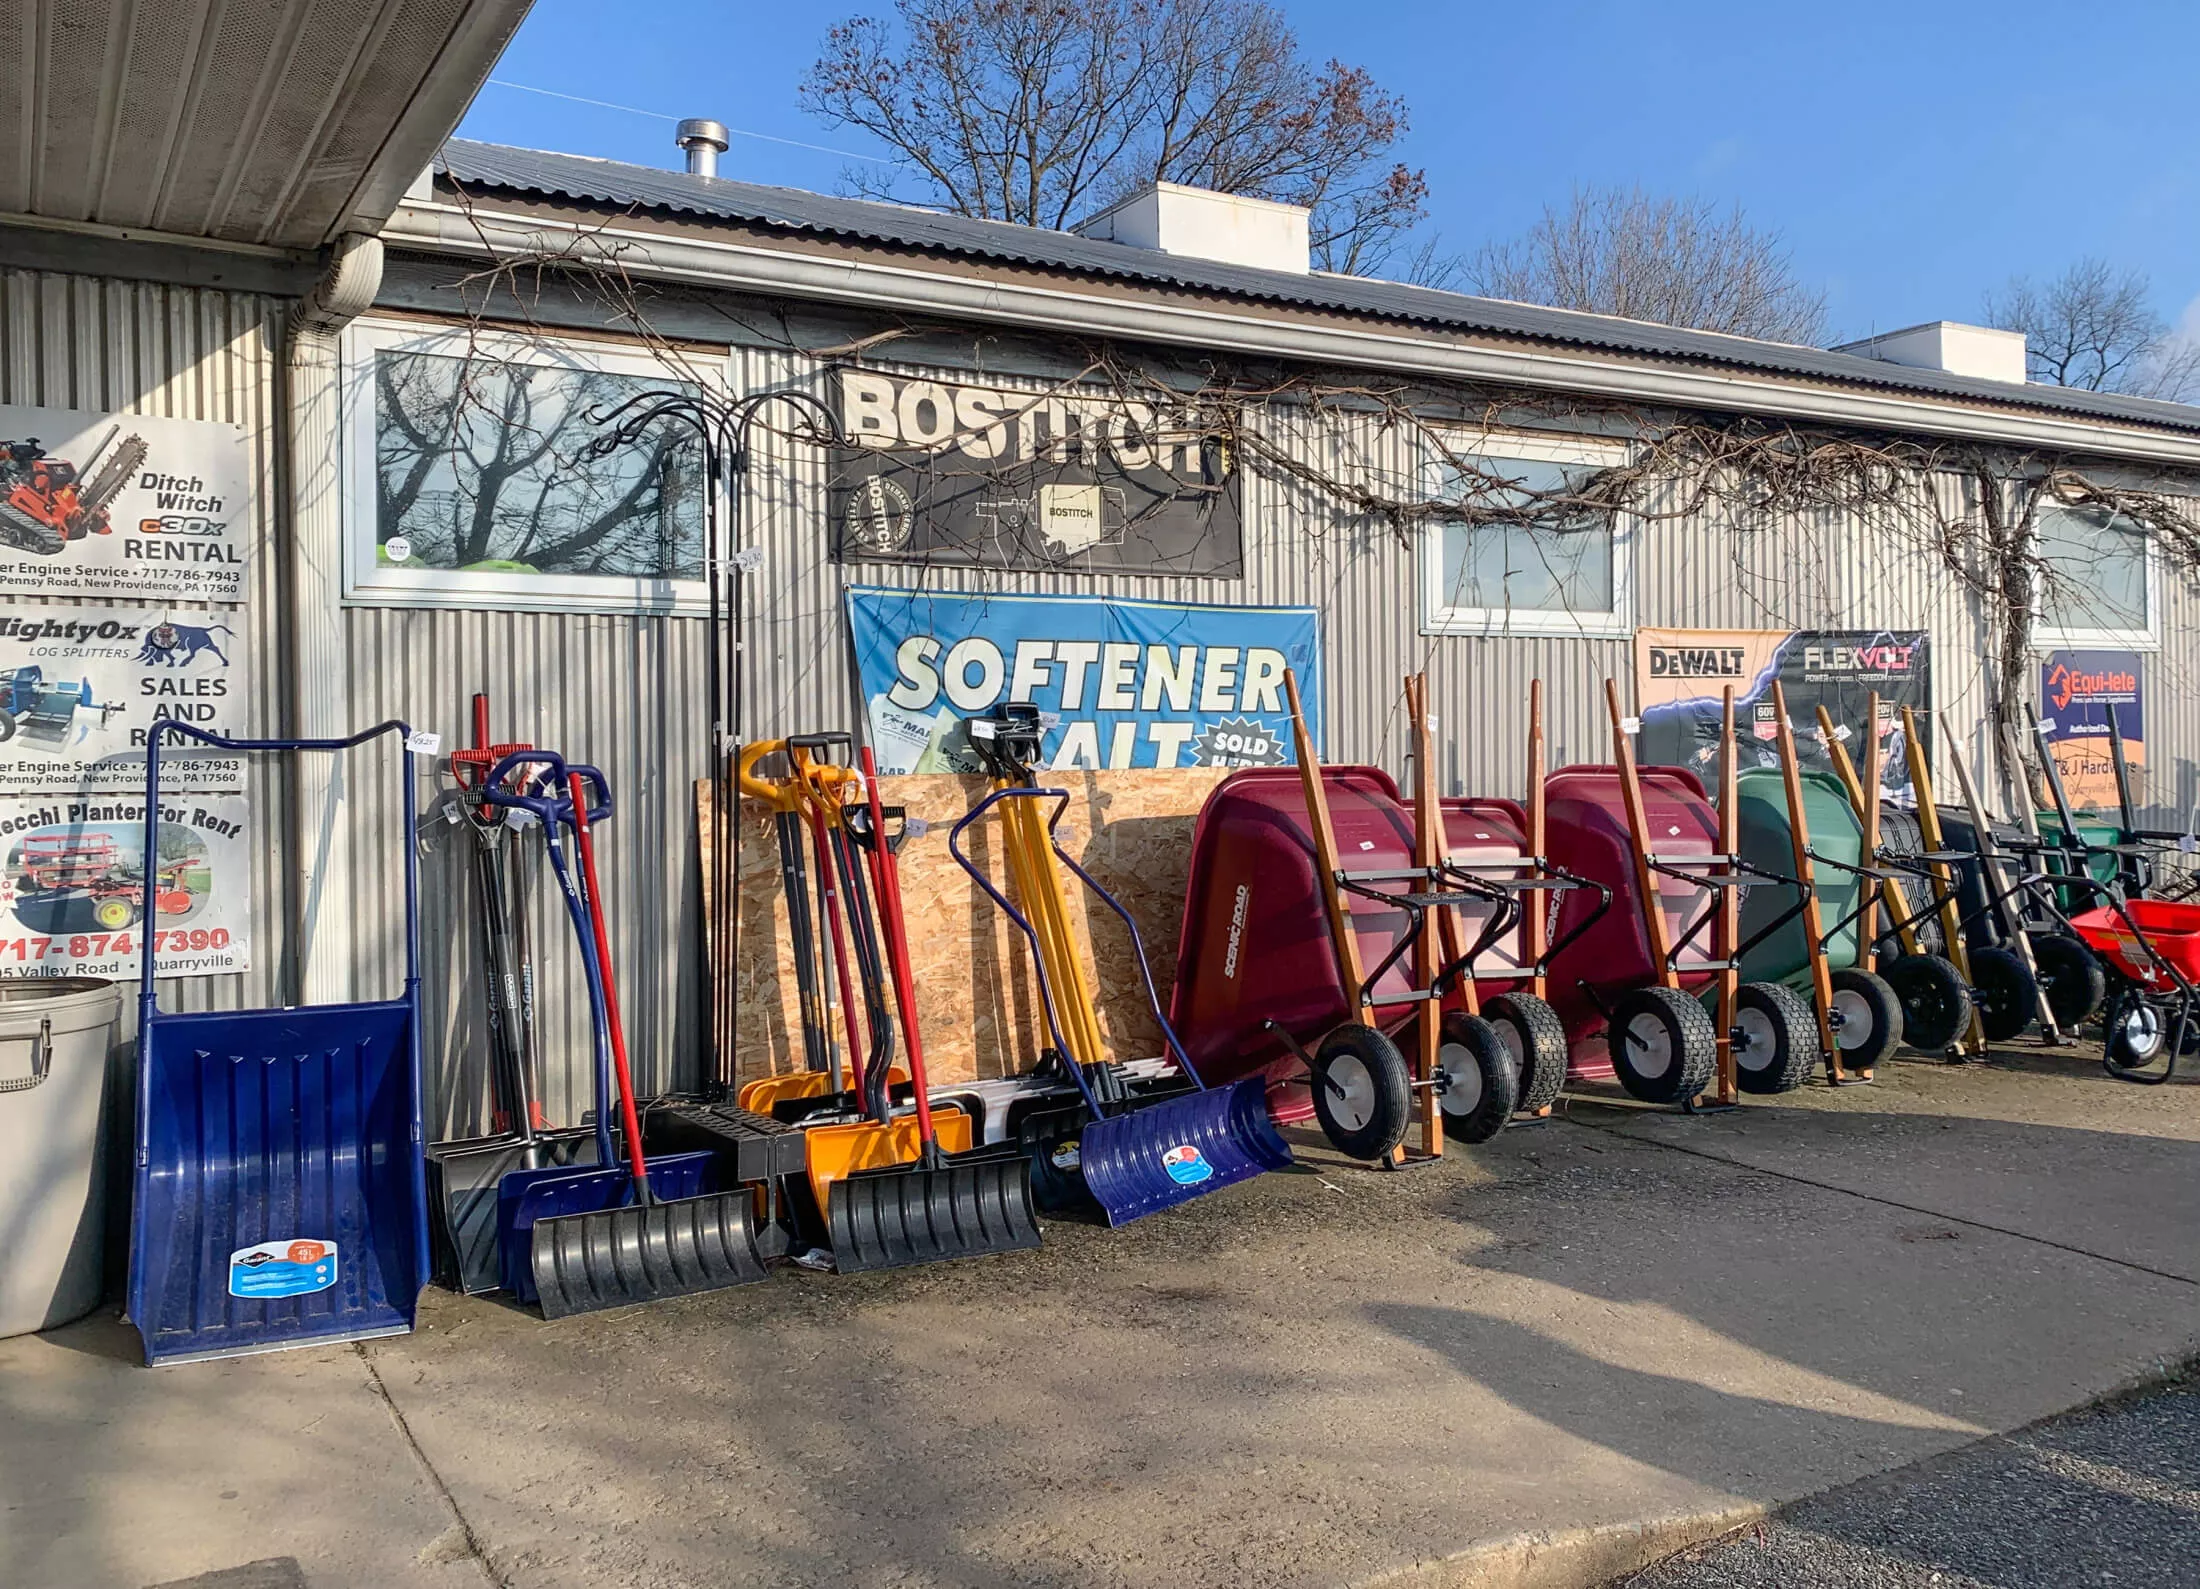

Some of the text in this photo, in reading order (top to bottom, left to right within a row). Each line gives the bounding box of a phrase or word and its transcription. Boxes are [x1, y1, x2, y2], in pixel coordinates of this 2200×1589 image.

[842, 373, 1201, 473] BOSTITCH
[140, 473, 203, 493] Ditch
[157, 492, 222, 513] Witch
[1049, 507, 1093, 518] BOSTITCH
[867, 474, 892, 553] BOSTITCH
[124, 539, 242, 563] RENTAL
[19, 563, 71, 577] Engine
[75, 564, 129, 577] Service
[142, 568, 240, 582] 717-786-7943
[0, 575, 237, 593] Pennsy Road, New Providence, PA 17560
[28, 647, 130, 658] LOG SPLITTERS
[1804, 646, 1913, 670] FLEXVOLT
[886, 636, 1287, 712] SOFTENER
[140, 678, 227, 697] SALES
[152, 704, 216, 721] AND
[1036, 721, 1195, 771] ALT
[1213, 732, 1270, 756] SOLD
[18, 761, 70, 774] Engine
[74, 761, 128, 771] Service
[141, 760, 239, 771] 77-786-7943
[46, 774, 80, 783] Road,
[83, 774, 110, 783] New
[113, 773, 181, 782] Province,
[184, 774, 198, 782] PA
[202, 774, 236, 782] 17560
[0, 806, 60, 836] ecchi
[67, 803, 145, 822] Planter
[192, 808, 242, 839] Rent
[1232, 884, 1247, 928] ROAD
[1224, 924, 1241, 979] SCENIC
[18, 965, 70, 976] Valley
[75, 961, 119, 975] Road
